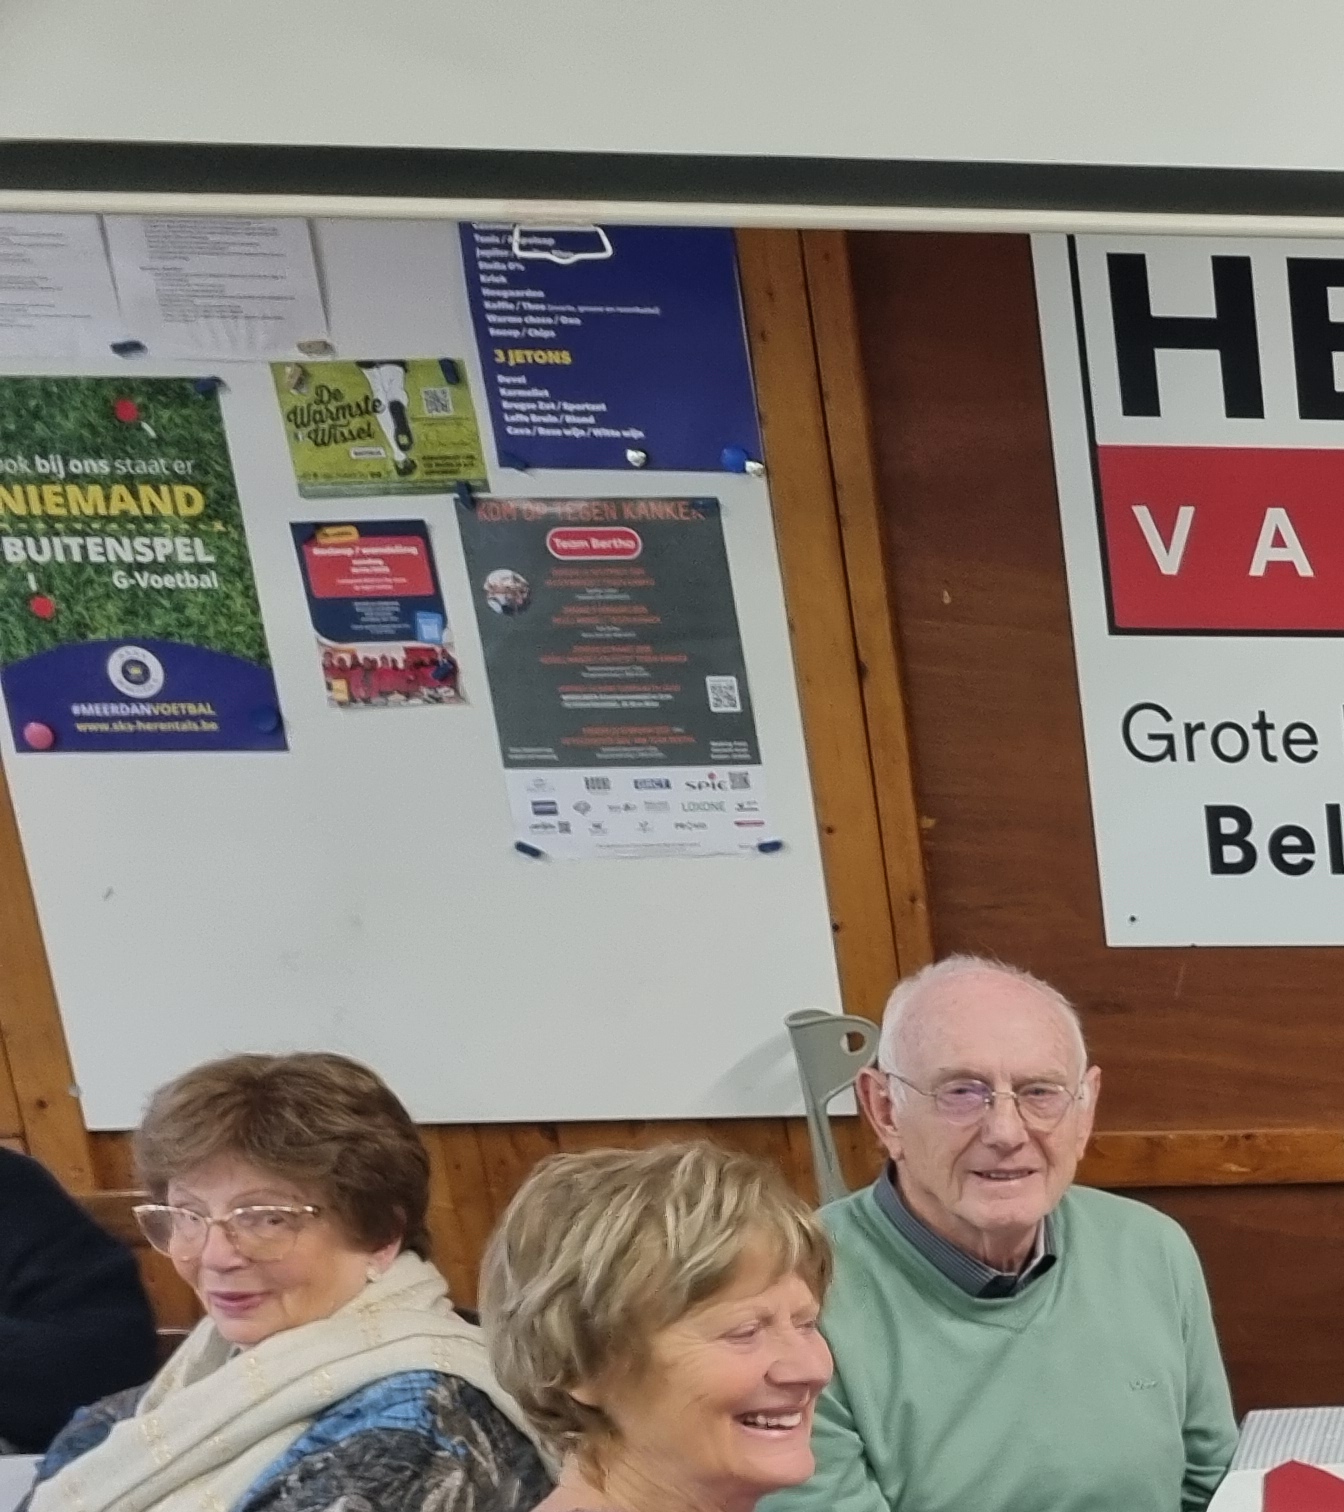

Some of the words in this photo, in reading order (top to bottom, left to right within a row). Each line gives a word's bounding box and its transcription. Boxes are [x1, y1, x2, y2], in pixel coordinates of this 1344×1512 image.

[494, 349, 506, 364] 3
[508, 349, 572, 366] JETONS
[314, 384, 344, 405] De
[286, 394, 386, 429] Warmste
[307, 422, 375, 448] Wissel
[0, 454, 32, 474] ok
[35, 454, 65, 479] bij
[69, 458, 110, 475] ons
[114, 458, 170, 475] staat
[172, 459, 196, 475] er
[0, 483, 206, 517] NIEMAND
[477, 501, 518, 522] KOM
[1, 535, 216, 564] BUITENSPEL
[552, 536, 590, 549] Team
[112, 569, 219, 590] G-Voetbal
[71, 702, 216, 717] #MEERDANVOETBAL
[75, 720, 220, 734] www.sks-herentals.be
[1121, 701, 1320, 765] Grote
